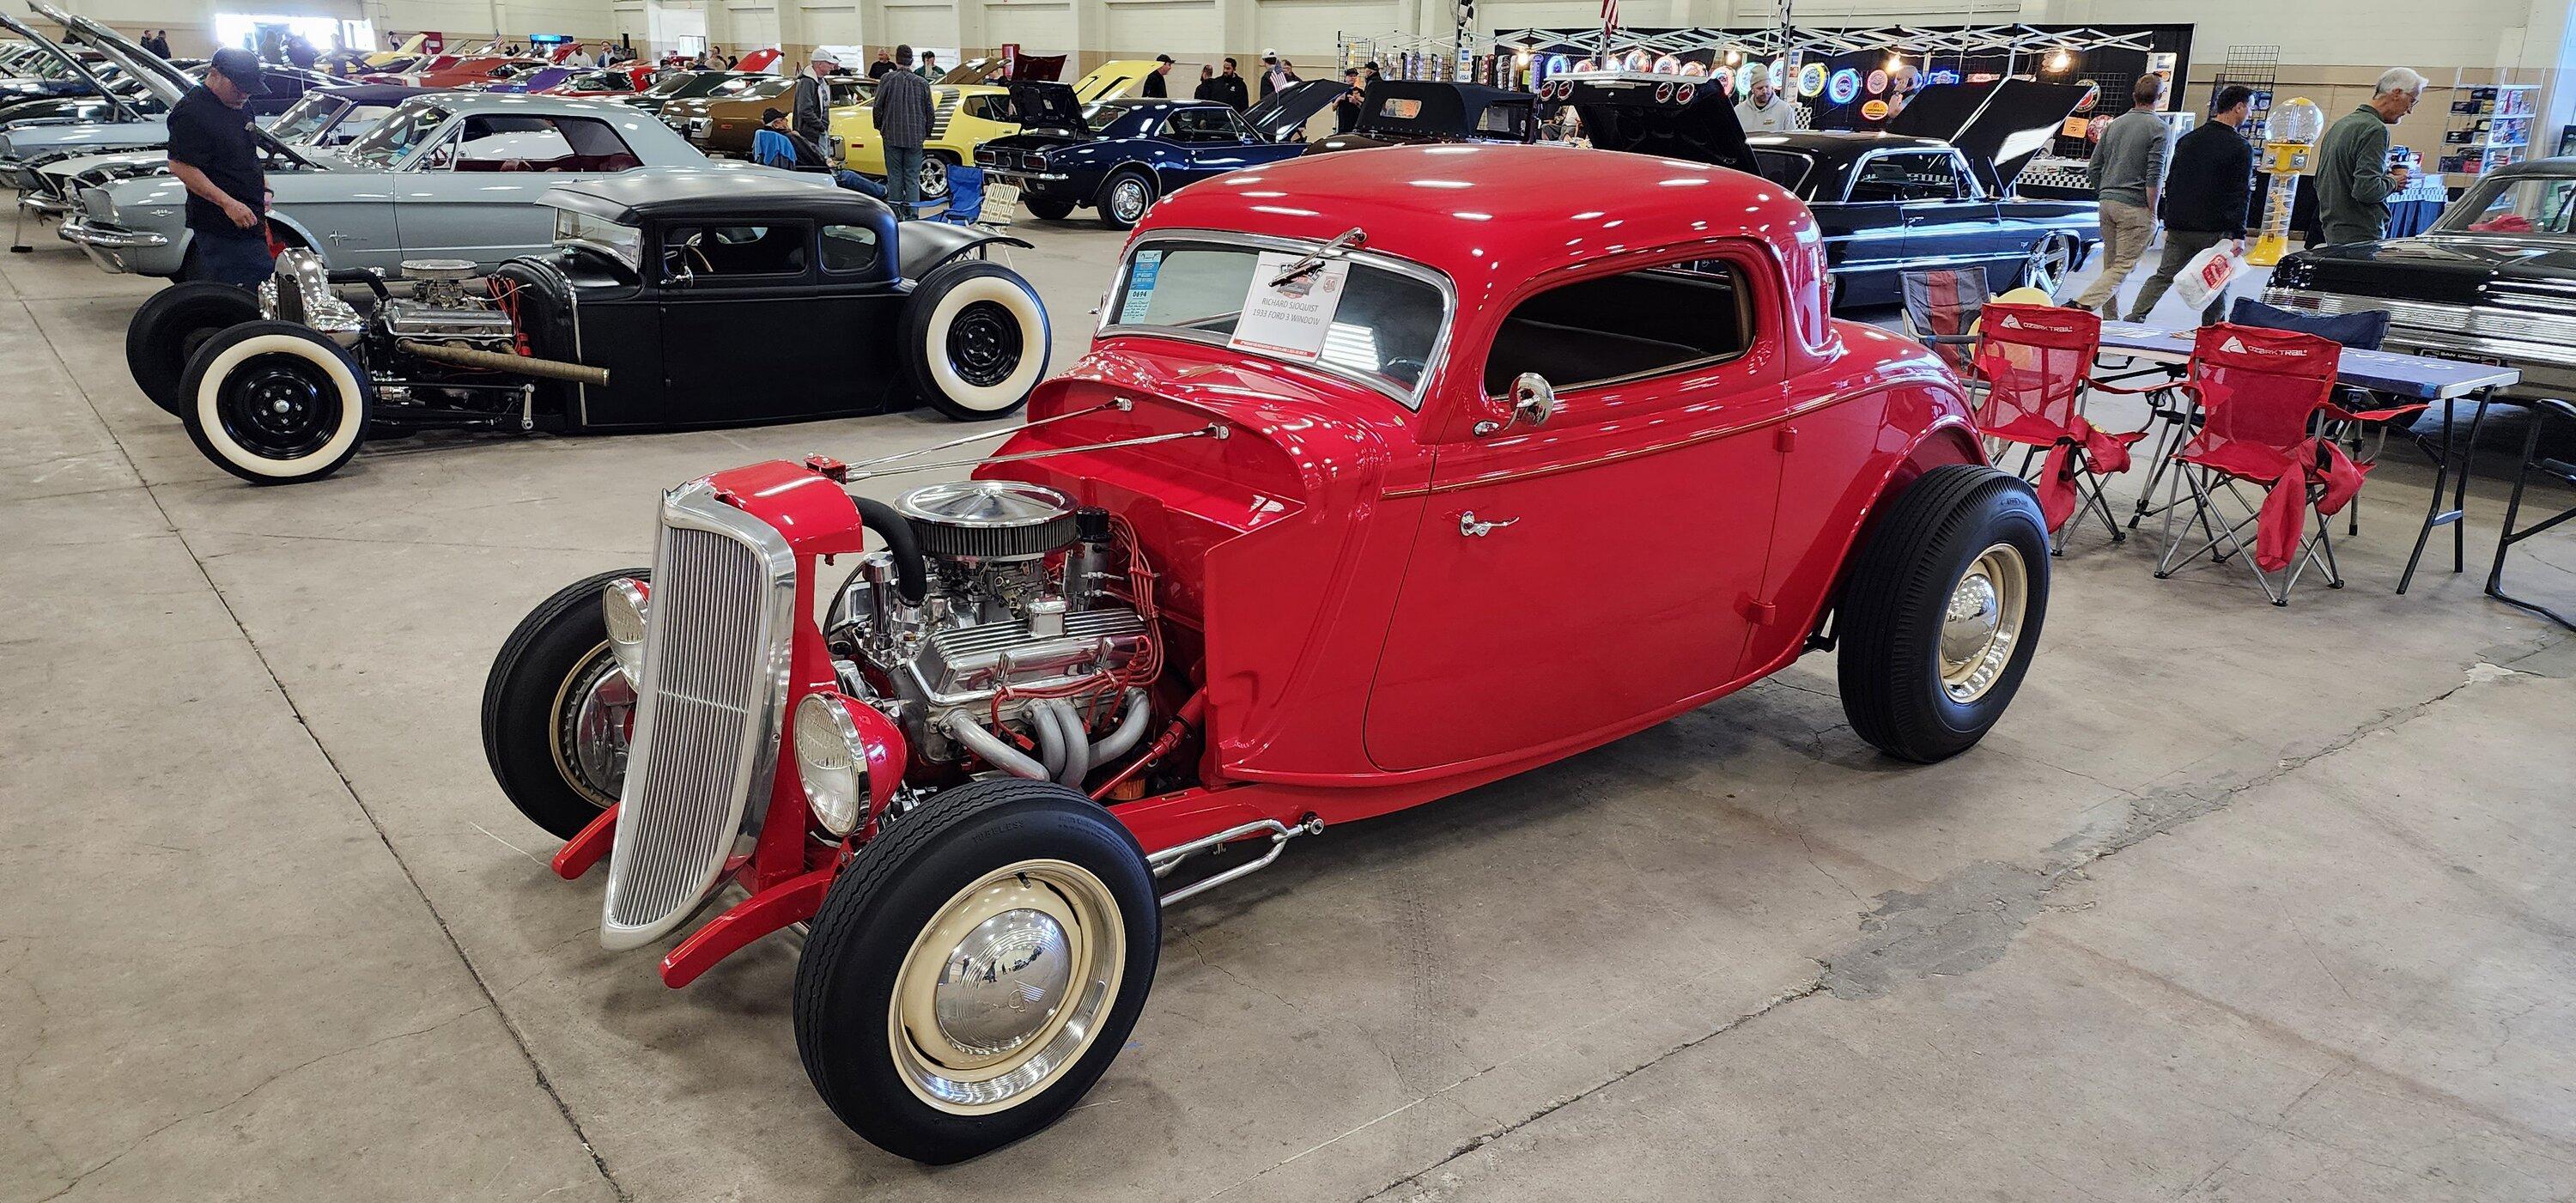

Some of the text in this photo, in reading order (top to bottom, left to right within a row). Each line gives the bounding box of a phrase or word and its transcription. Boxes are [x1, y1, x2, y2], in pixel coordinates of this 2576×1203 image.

[1261, 297, 1288, 308] RICHARD
[1253, 308, 1267, 318] 1933
[1268, 311, 1285, 320] FORD
[1291, 313, 1321, 325] WINDOW
[2023, 322, 2049, 331] OZARK
[2247, 345, 2278, 355] OZARK
[972, 819, 1024, 844] TUBELESS
